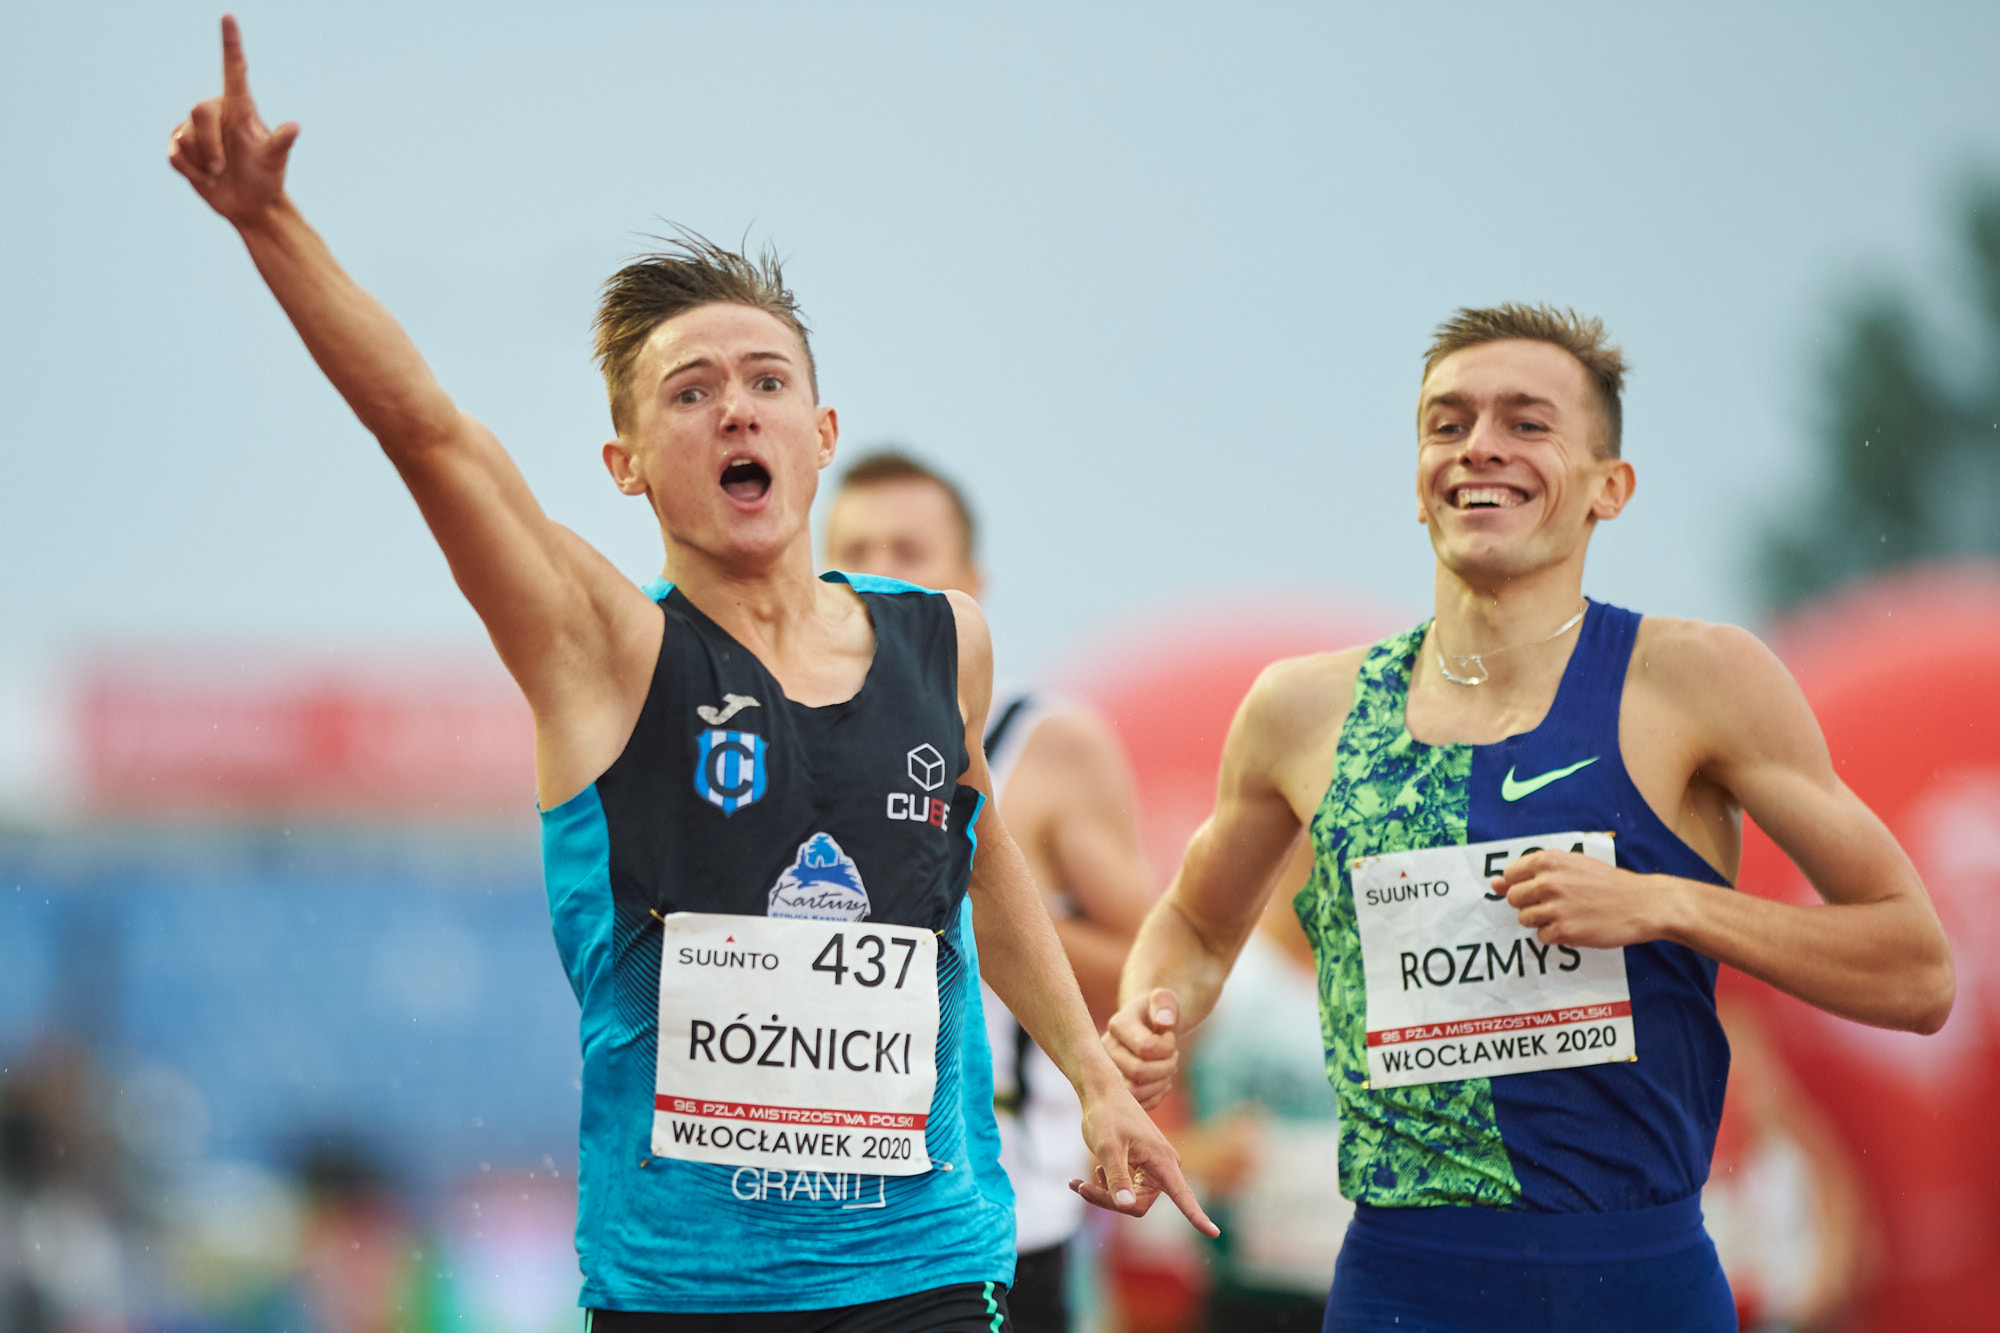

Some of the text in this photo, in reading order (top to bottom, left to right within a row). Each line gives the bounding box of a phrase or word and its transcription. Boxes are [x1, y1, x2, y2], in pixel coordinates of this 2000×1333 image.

[887, 792, 950, 832] CUBE
[771, 882, 867, 922] Kartuzy
[1366, 881, 1450, 906] SUUNTO
[678, 947, 780, 971] SUUNTO
[811, 933, 918, 989] 437
[1400, 937, 1582, 991] ROZMYS
[1405, 1026, 1444, 1040] PZLA
[1446, 1013, 1556, 1035] MISTRZOSTWA
[1558, 1006, 1613, 1021] POLSKI
[688, 1013, 912, 1075] RÓŻNICKI
[1382, 1025, 1617, 1073] WŁOCŁAWEK 2020
[673, 1099, 914, 1128] 96. PZLA MISTRZOSTWA POLSKI
[672, 1120, 912, 1161] WŁOCŁAWEK 2020
